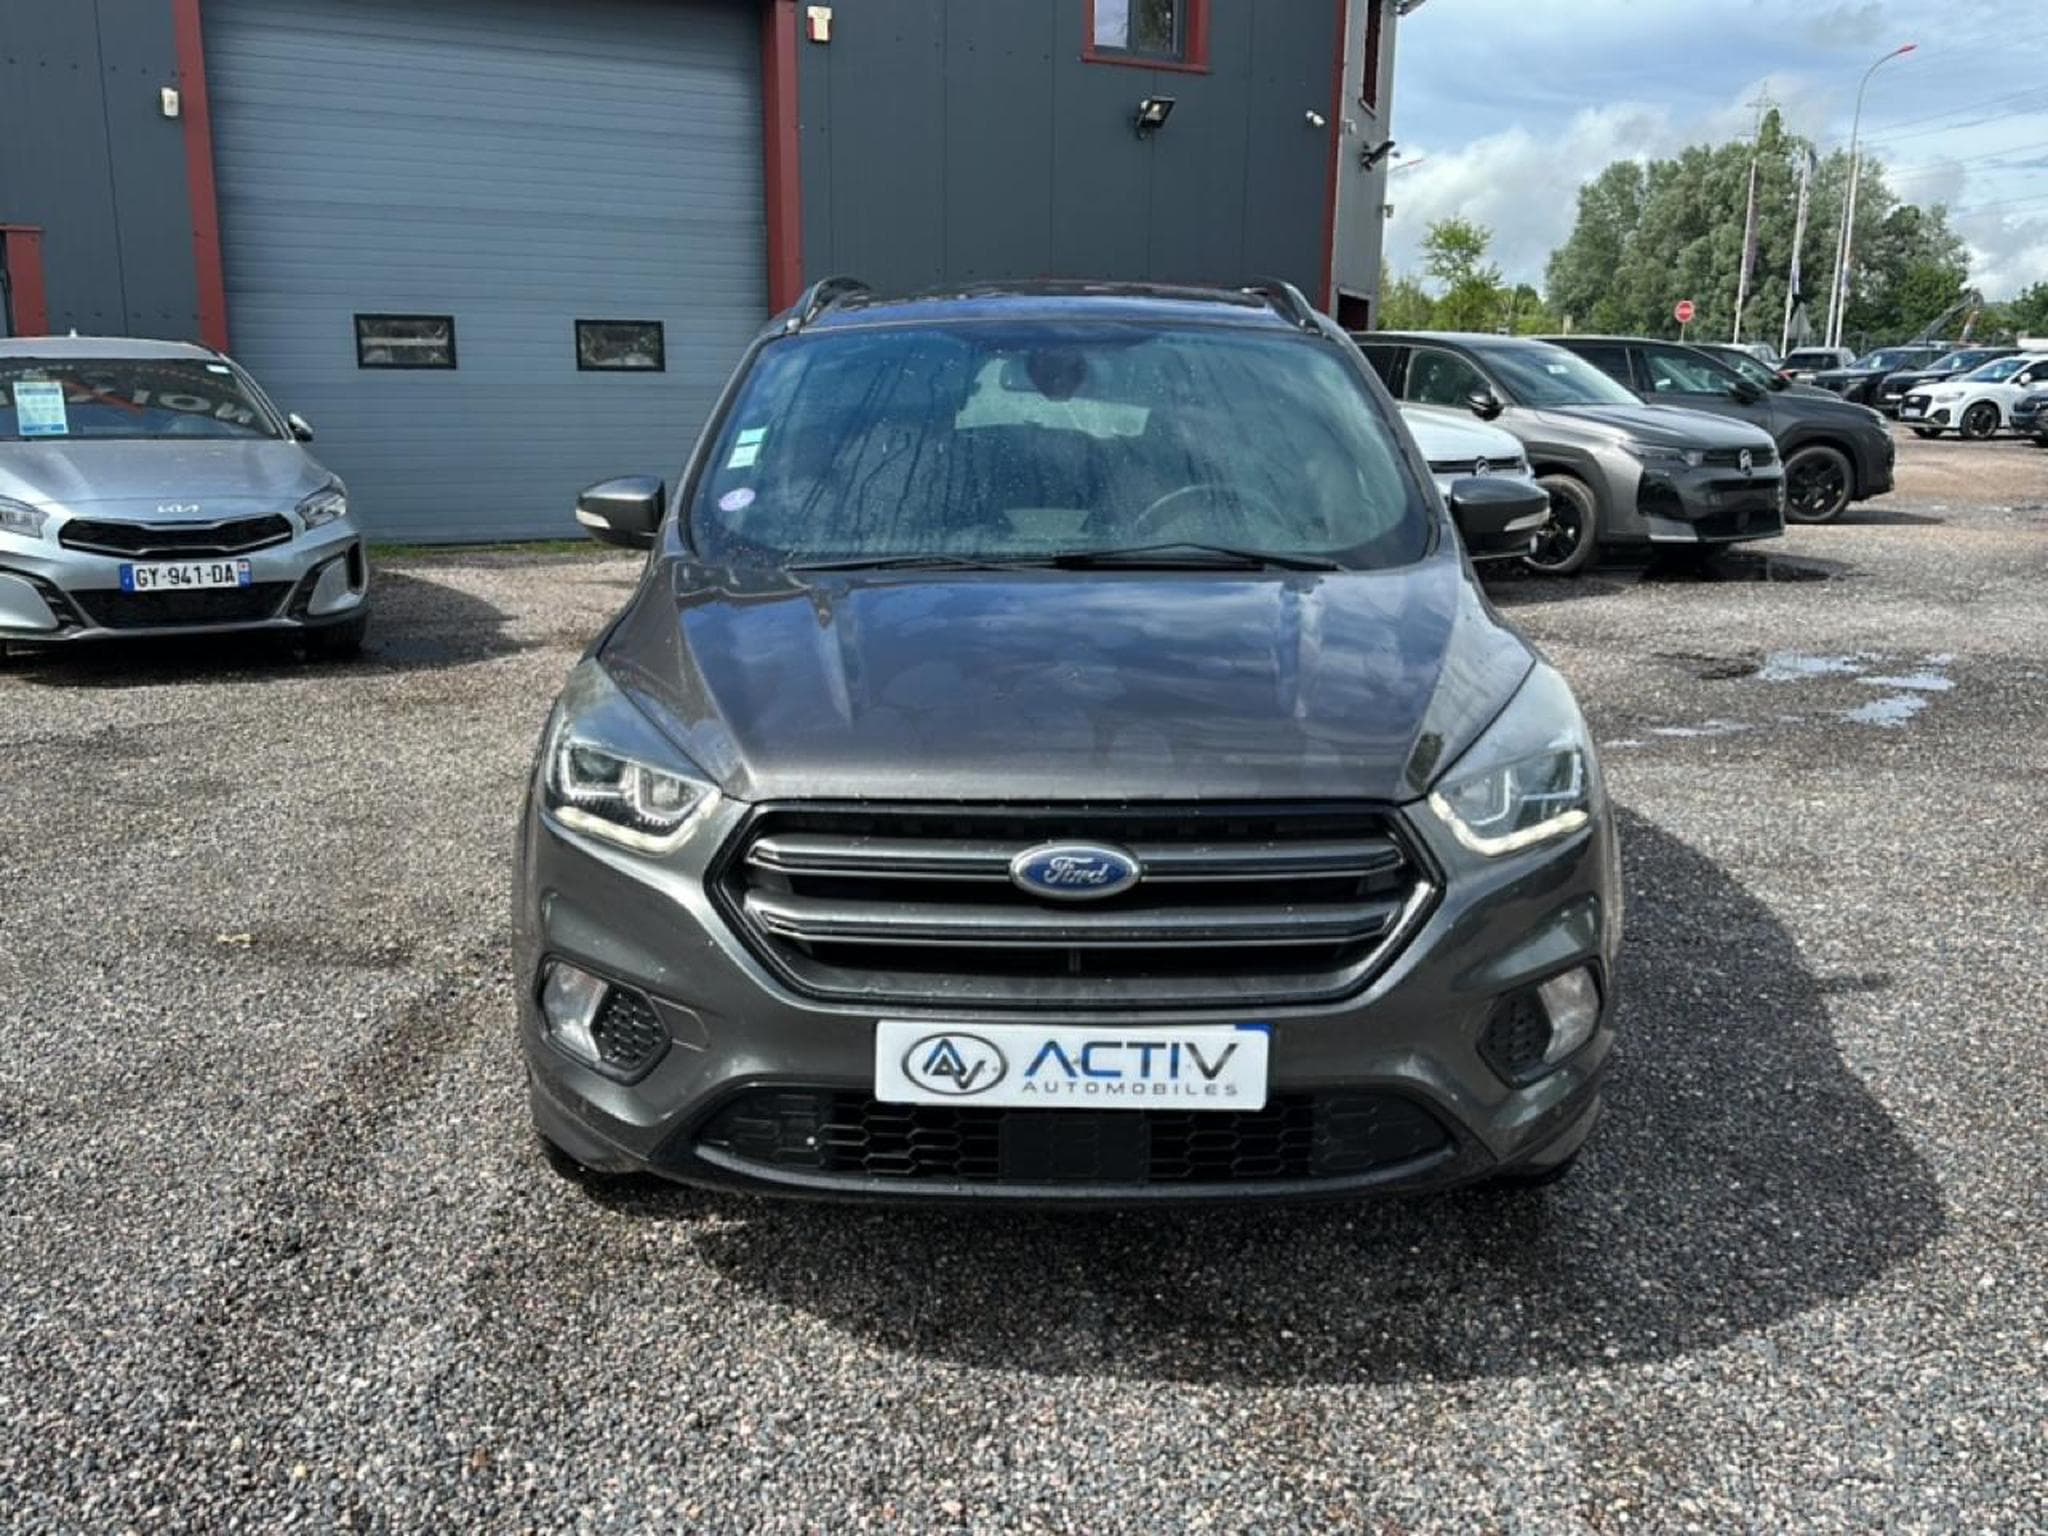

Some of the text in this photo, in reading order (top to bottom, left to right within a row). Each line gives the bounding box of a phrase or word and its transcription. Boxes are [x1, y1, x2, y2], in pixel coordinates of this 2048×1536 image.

[135, 564, 235, 587] GY-941-DA
[1044, 857, 1109, 884] Ford
[1024, 1040, 1239, 1080] ACTIV
[1022, 1081, 1238, 1096] AUTOMOBILES
